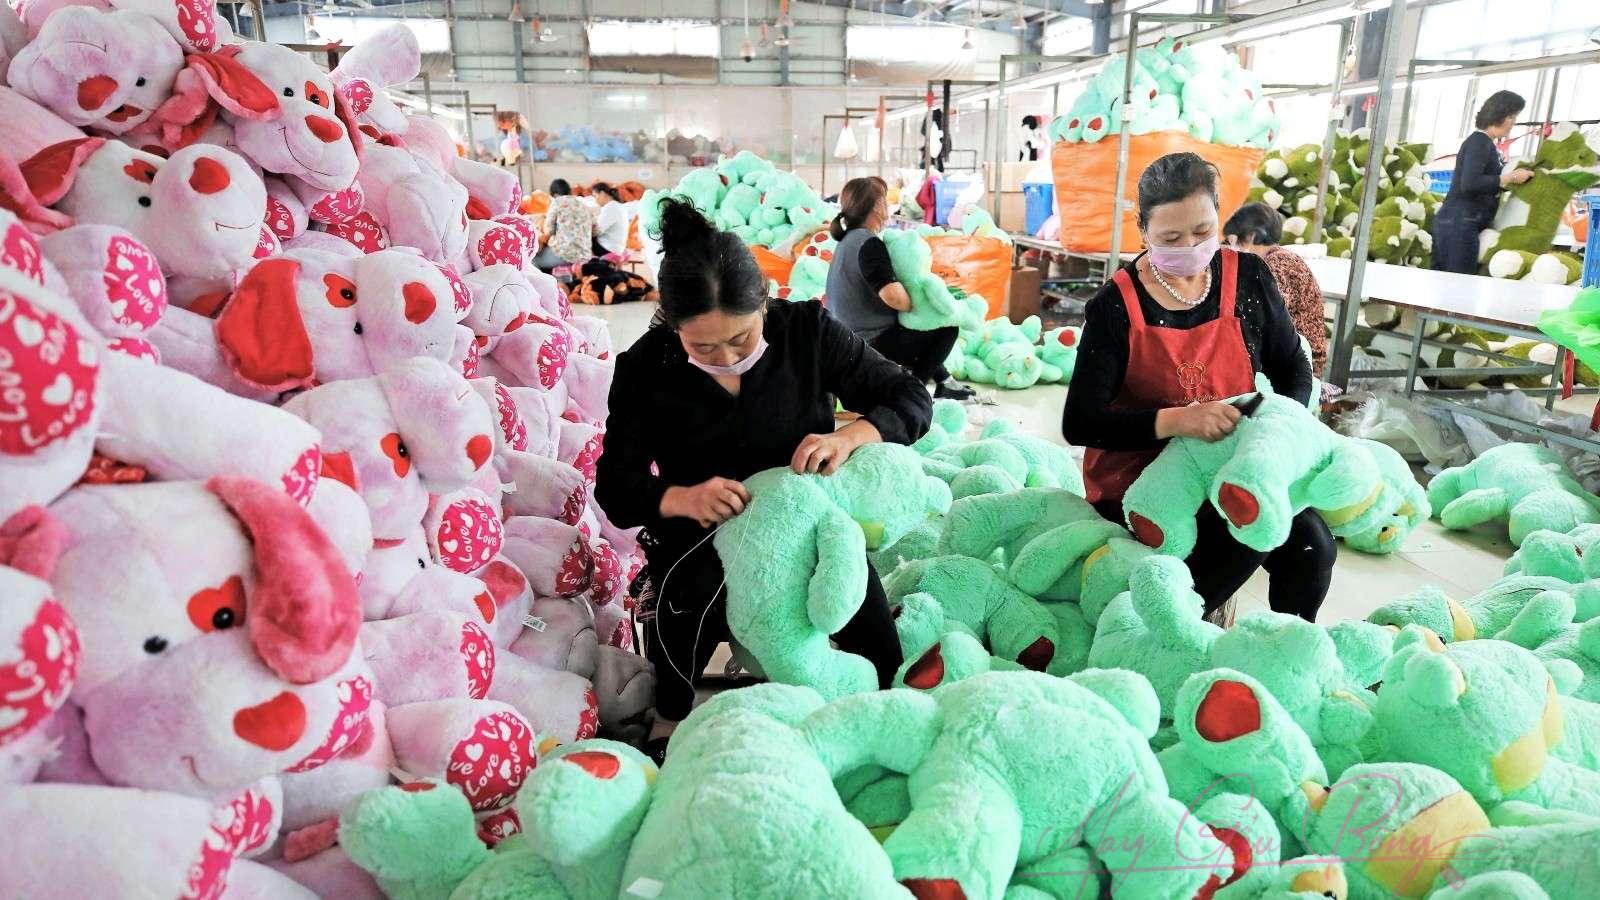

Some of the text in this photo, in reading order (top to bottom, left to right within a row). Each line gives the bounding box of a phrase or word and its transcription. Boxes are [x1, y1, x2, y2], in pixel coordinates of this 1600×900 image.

[273, 199, 291, 222] ove
[353, 219, 380, 240] Love
[116, 241, 153, 272] Love
[125, 273, 154, 314] Love
[20, 388, 88, 447] Love
[458, 525, 473, 563] Love
[476, 525, 497, 547] Love
[5, 659, 46, 702] Lo
[480, 716, 500, 740] Lo
[449, 760, 475, 776] ve
[465, 753, 500, 797] Love
[507, 740, 521, 787] Love
